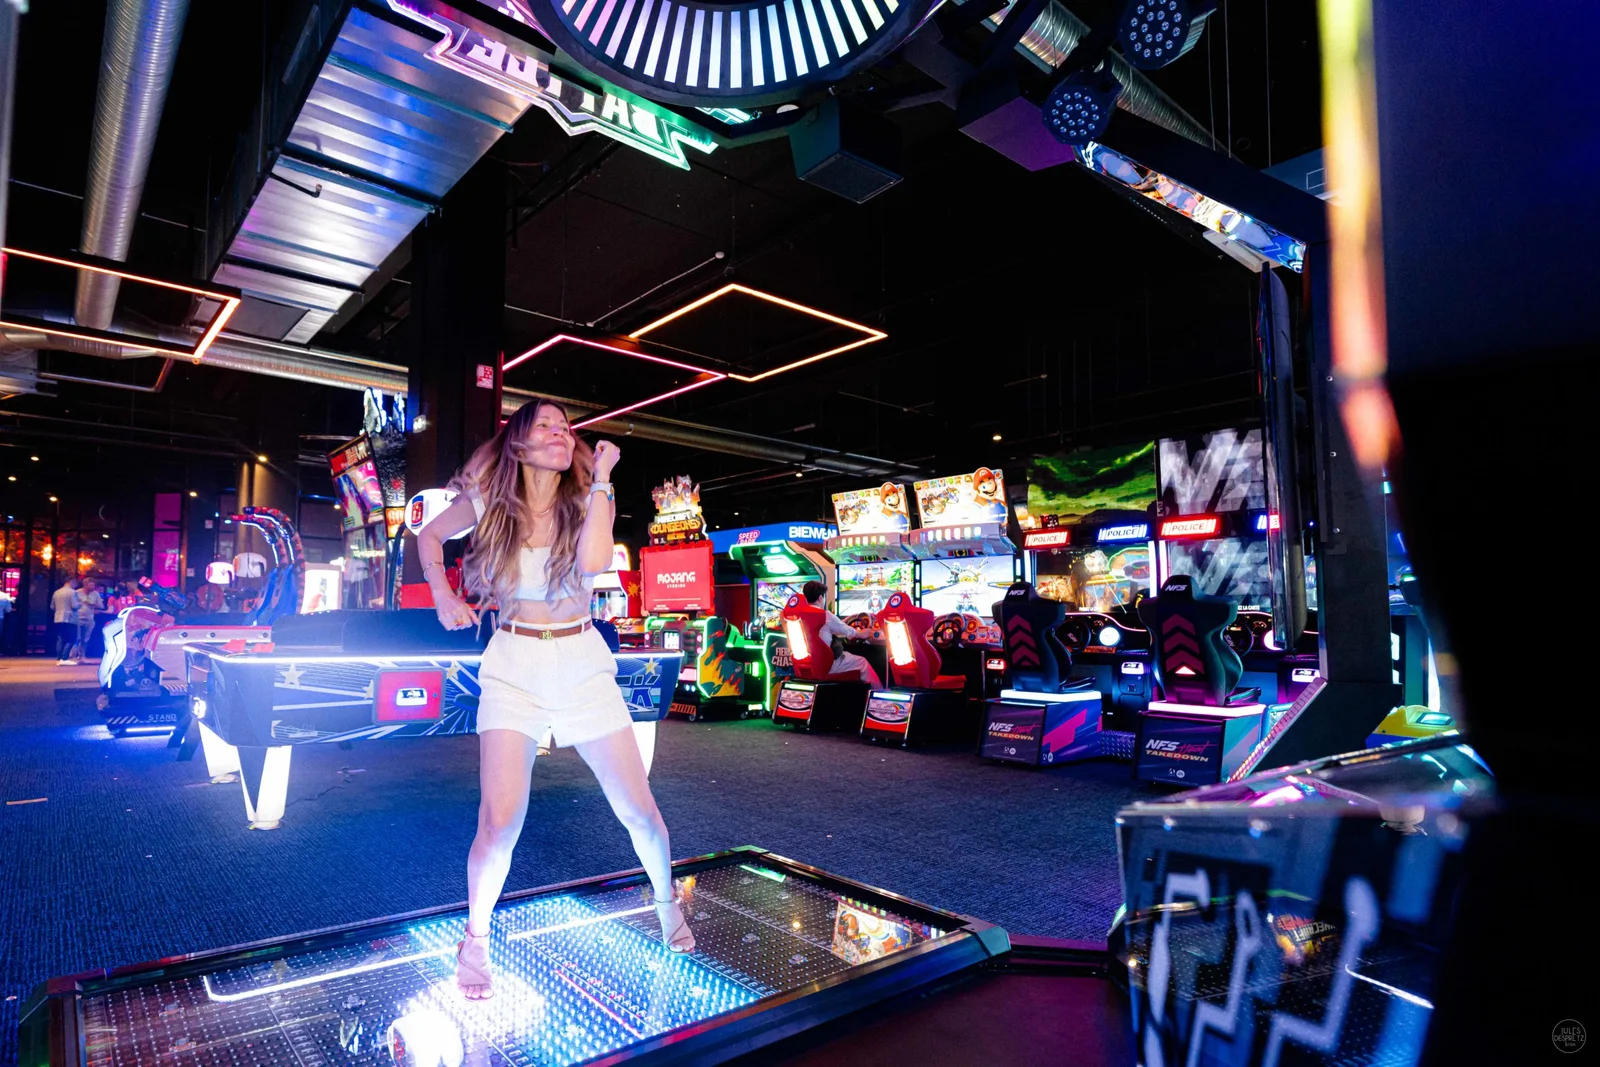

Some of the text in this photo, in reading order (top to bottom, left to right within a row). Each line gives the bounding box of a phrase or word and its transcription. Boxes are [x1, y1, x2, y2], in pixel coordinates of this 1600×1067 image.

[650, 519, 701, 534] DUNGEONS
[1172, 523, 1206, 532] POLICE
[738, 531, 759, 540] SPEED
[1107, 528, 1138, 537] POLICE
[1033, 534, 1058, 543] POLICE
[657, 571, 696, 584] MOJANG
[1165, 583, 1188, 592] NFS
[988, 722, 1014, 732] NFS
[988, 731, 1034, 741] TAKEDOWN
[1145, 739, 1180, 752] NFS
[1145, 749, 1209, 762] TAKEDOWN
